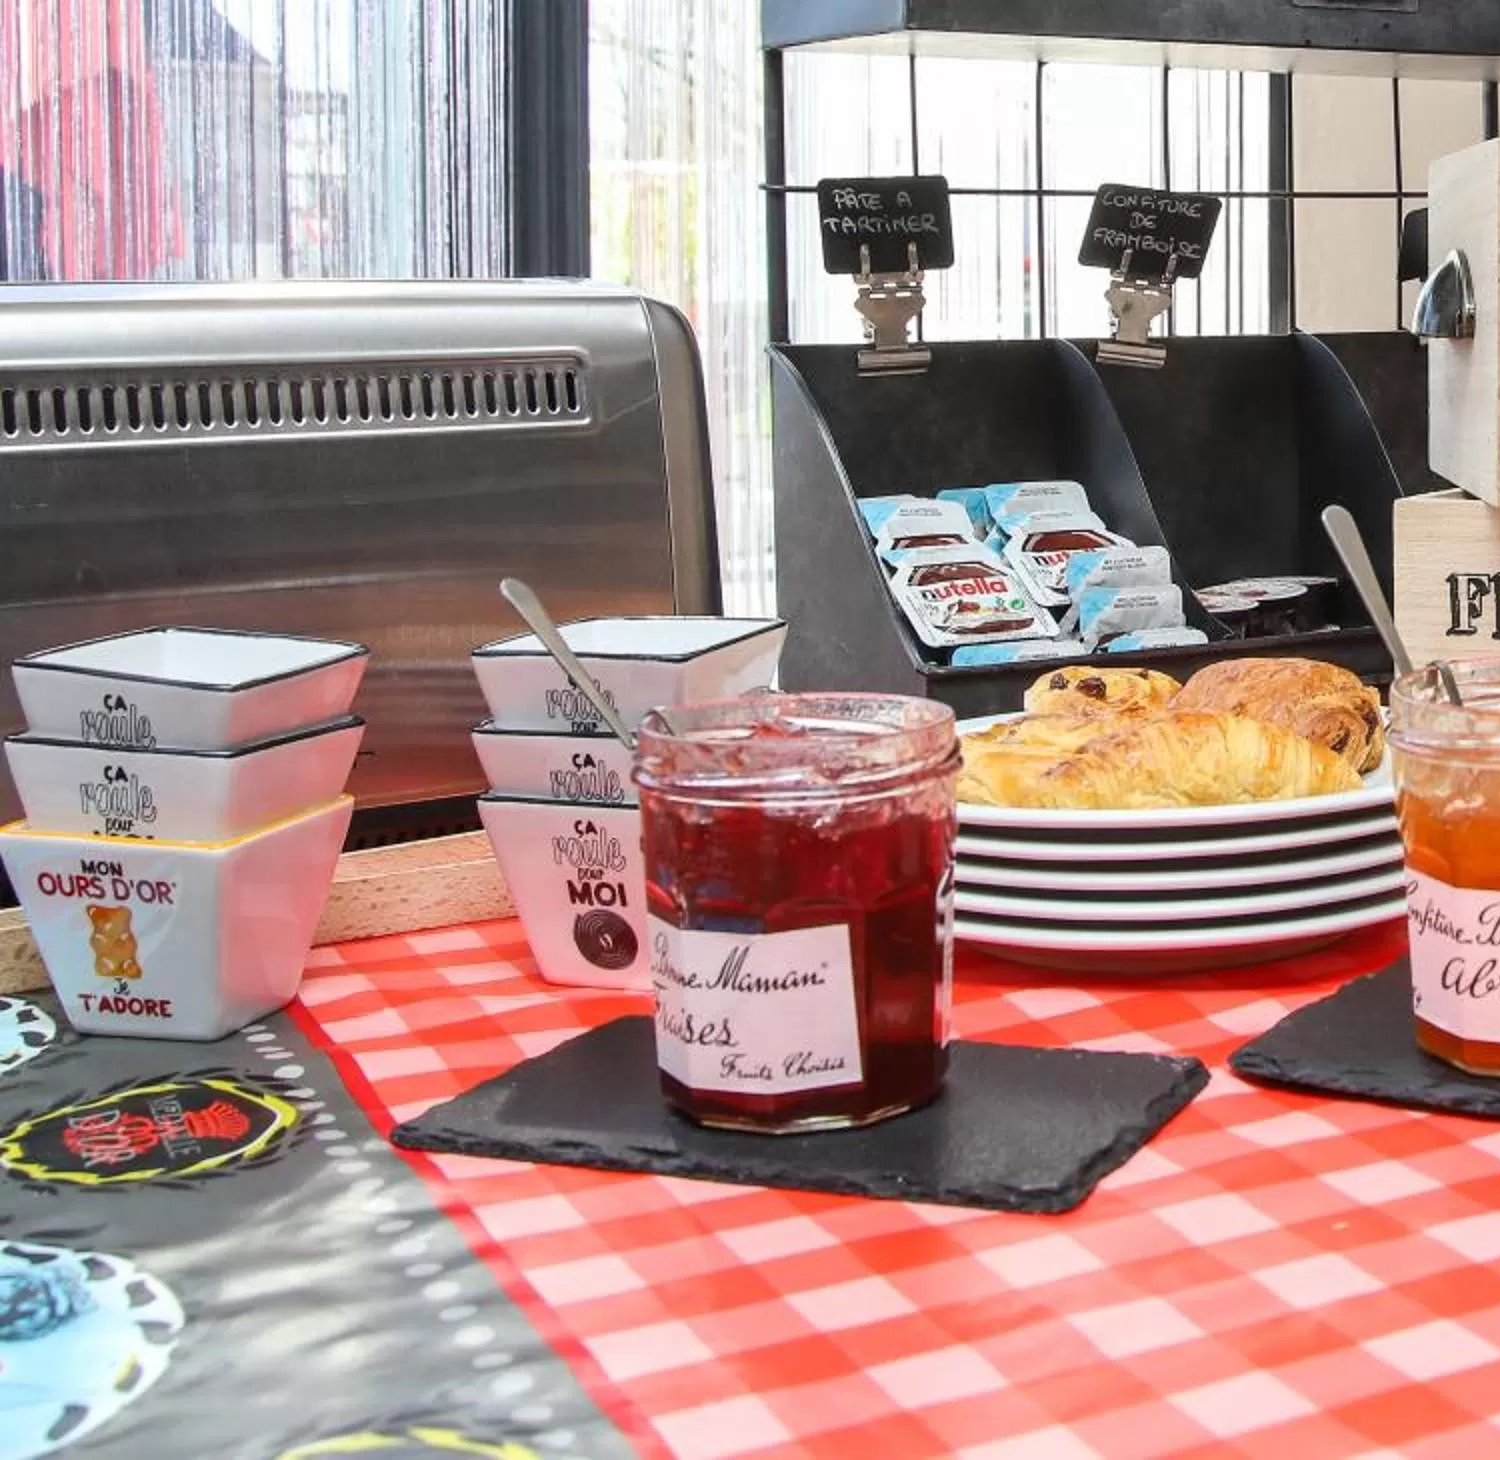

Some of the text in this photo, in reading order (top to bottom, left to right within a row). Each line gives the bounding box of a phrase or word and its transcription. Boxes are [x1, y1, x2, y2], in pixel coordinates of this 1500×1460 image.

[921, 575, 1009, 600] nutella
[103, 694, 128, 713] ÇA
[80, 704, 157, 748] roule
[103, 765, 129, 784] ÇA
[572, 753, 597, 771] ÇA
[550, 760, 625, 802] roule
[80, 774, 158, 822] roule
[105, 818, 134, 834] pour
[574, 820, 598, 838] ÇA
[552, 828, 627, 872] roule
[80, 859, 123, 877] MON
[38, 872, 106, 899] OURS
[567, 880, 628, 907] MOI
[1406, 880, 1473, 944] onfiture
[705, 944, 825, 993] Maman
[78, 993, 174, 1018] T'ADORE
[656, 1000, 739, 1047] raises
[720, 1051, 846, 1080] Fruits Choisis
